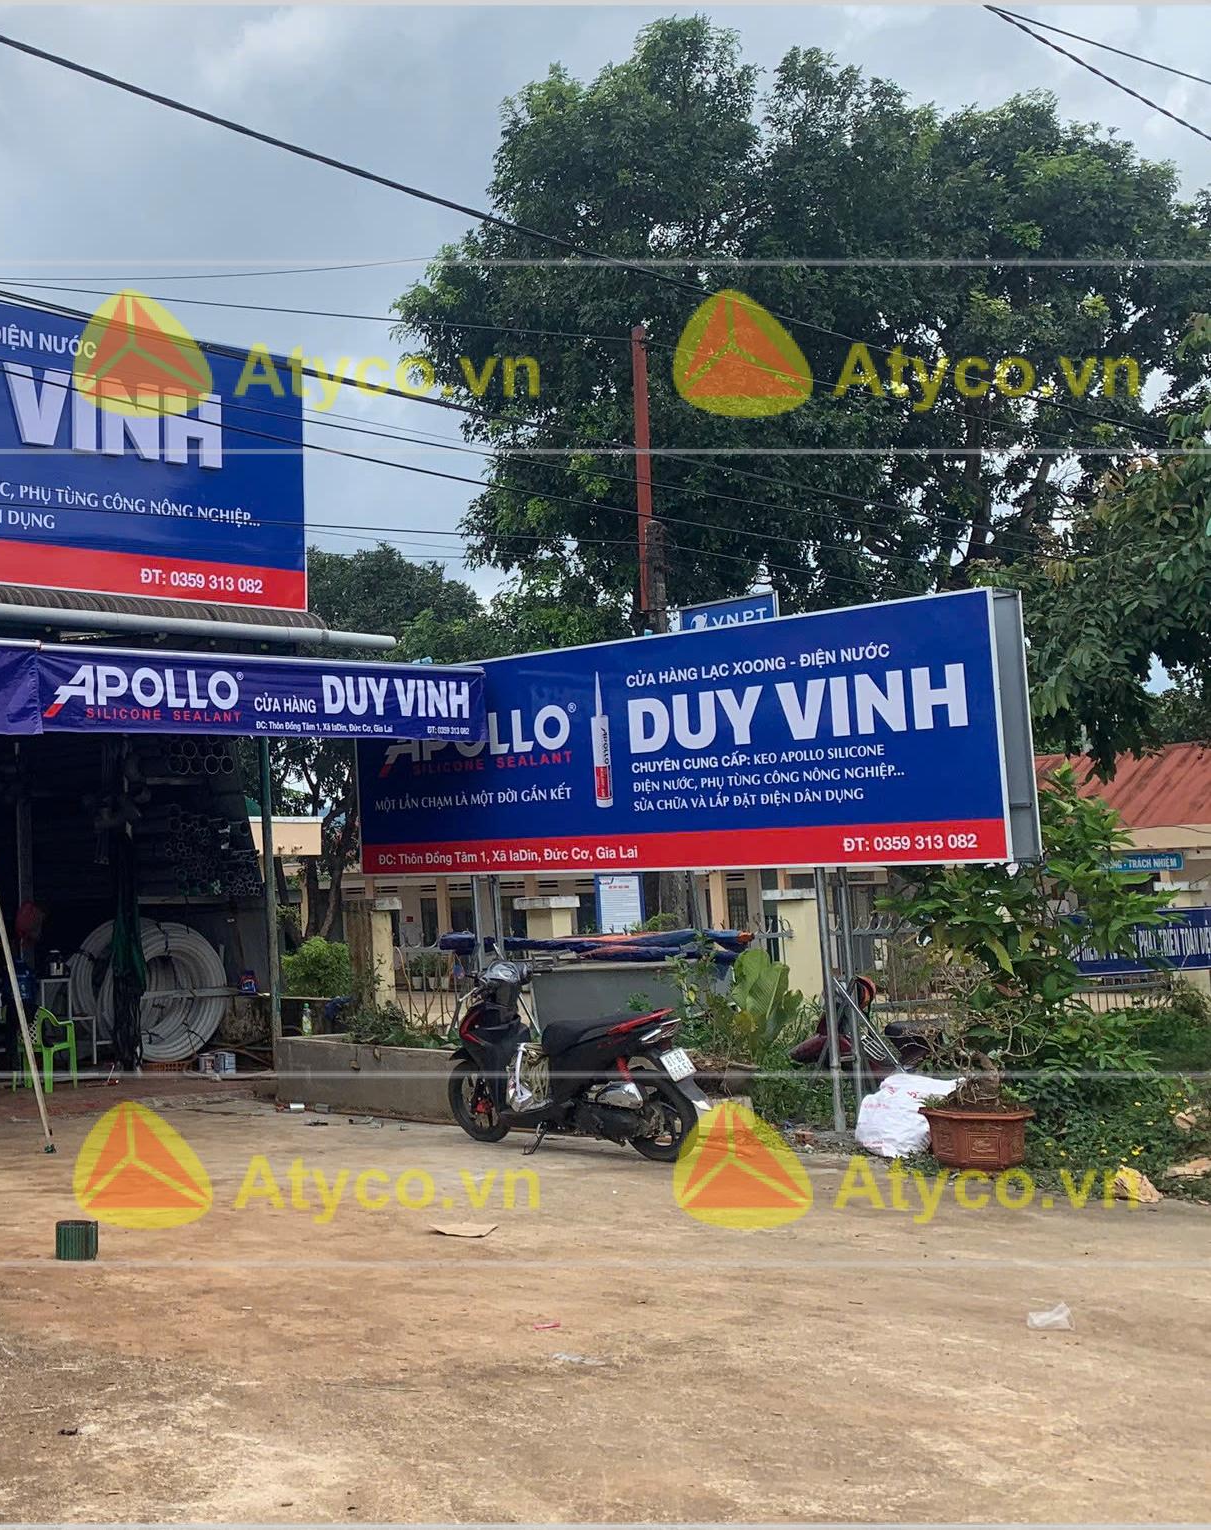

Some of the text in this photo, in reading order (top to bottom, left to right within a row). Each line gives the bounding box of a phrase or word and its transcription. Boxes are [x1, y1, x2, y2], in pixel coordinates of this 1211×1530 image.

[39, 331, 97, 359] NƯỚC
[3, 361, 223, 470] VINH
[20, 485, 52, 505] PHỤ
[56, 486, 99, 509] TÙNG
[103, 492, 146, 513] CÔNG
[151, 499, 193, 517] NÔNG
[8, 509, 56, 529] DỤNG
[141, 568, 263, 594] ĐT: 0359 313 082
[713, 607, 768, 626] VNPT
[626, 642, 890, 688] CỬA HÀNG LẠC XOONG ĐIỆN NƯỚC
[43, 664, 239, 717] APOLLO
[254, 675, 470, 719] CỬA HÀNG DUY VINH
[86, 706, 241, 723] SILICONE SEALANT
[627, 662, 969, 754] DUY VINH
[413, 750, 572, 775] SILICONE SEALANT
[631, 744, 885, 774] CHUYÊN CUNG CẤP: KEO APOLLO SILICONE
[633, 762, 905, 795] ĐIỆN NƯỚC, PHỤ TÙNG CÔNG NÔNG NGHIỆP...
[375, 797, 398, 813] MỘT
[422, 795, 454, 812] CHẠM
[454, 790, 469, 806] LÀ
[470, 789, 494, 806] MỘT
[497, 787, 519, 803] ĐỜI
[521, 783, 547, 803] GẮN
[550, 781, 572, 800] KẾT
[656, 796, 688, 810] CHỮA
[691, 793, 707, 808] VÀ
[709, 791, 729, 807] LẮP
[733, 793, 757, 808] ĐẶT
[761, 790, 791, 807] ĐIỆN
[794, 787, 823, 802] DÂN
[825, 787, 864, 804] DỤNG
[378, 853, 396, 865] ĐC:
[399, 852, 423, 865] Thôn
[426, 851, 452, 866] Đồng
[454, 850, 478, 863] Tâm
[492, 849, 507, 862] Xã
[544, 847, 569, 861] Đức
[571, 847, 593, 861] Cơ,
[596, 846, 616, 860] Gia
[619, 845, 638, 859] Lai
[843, 833, 977, 852] ĐT: 0359 313 082
